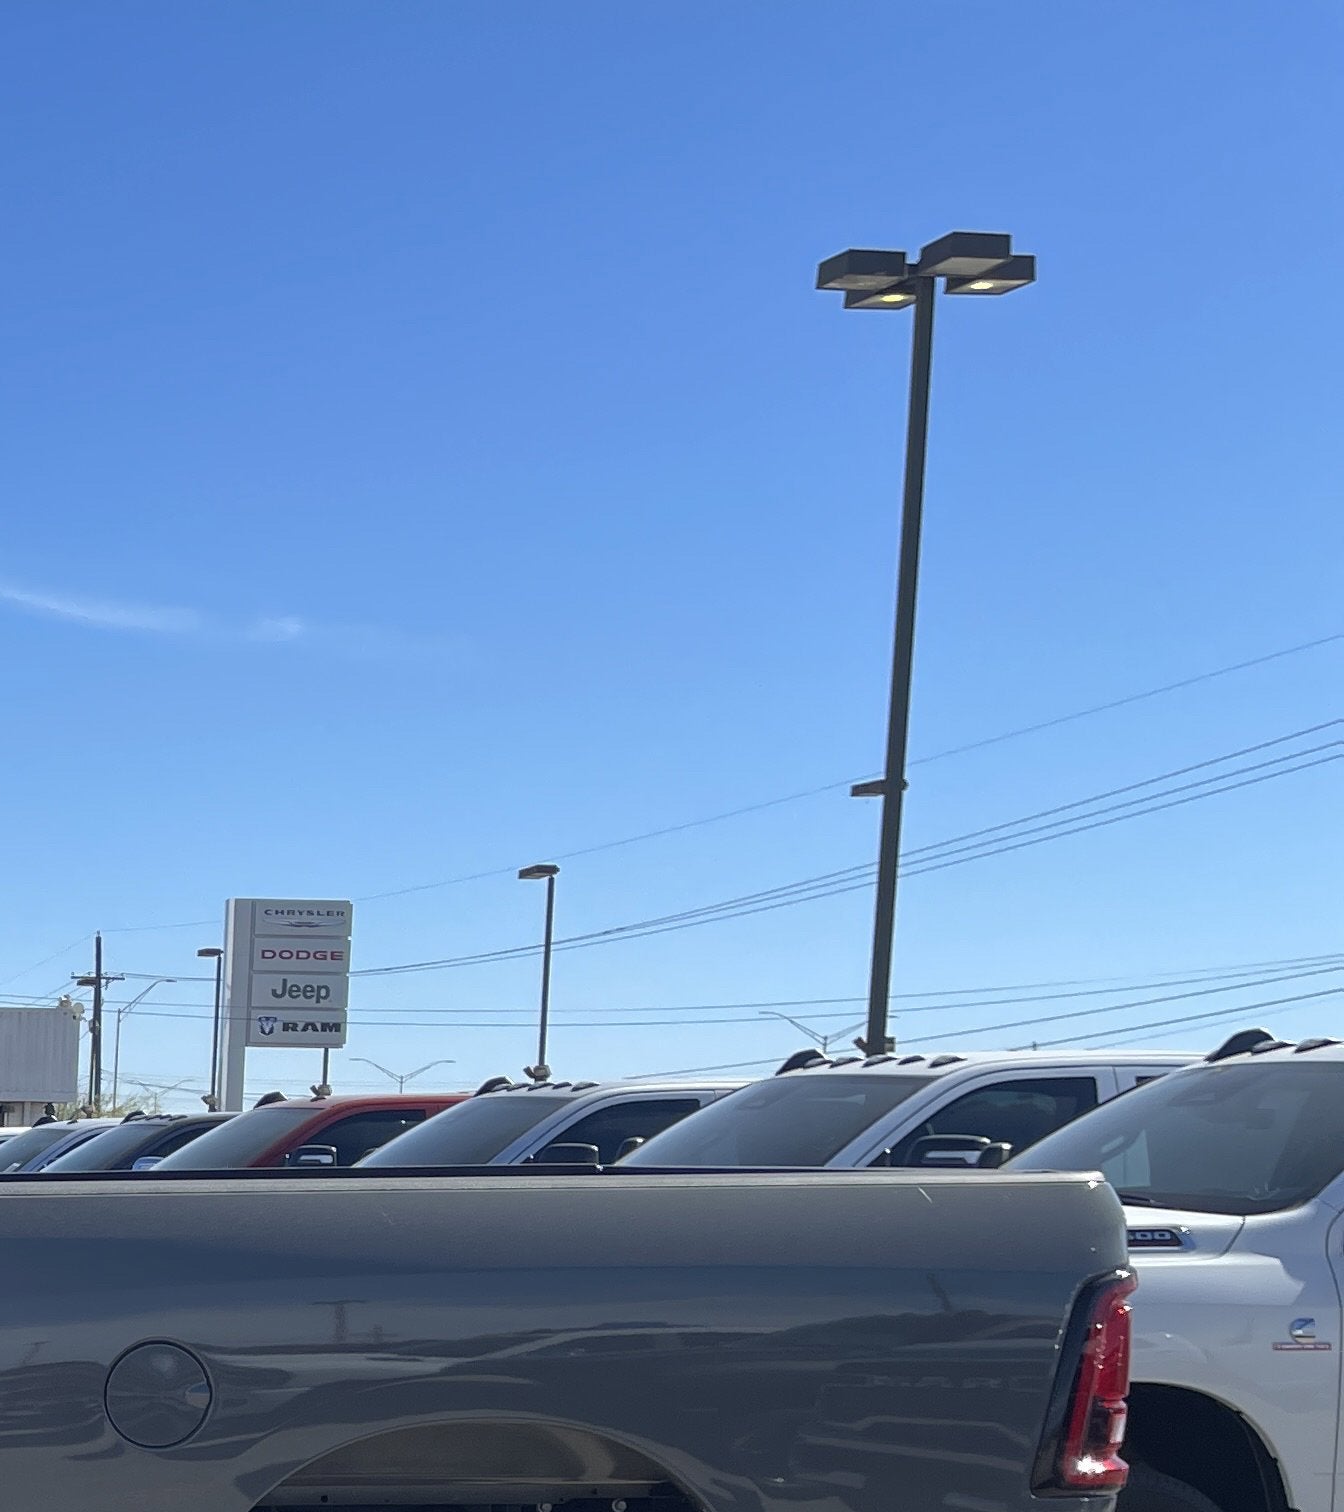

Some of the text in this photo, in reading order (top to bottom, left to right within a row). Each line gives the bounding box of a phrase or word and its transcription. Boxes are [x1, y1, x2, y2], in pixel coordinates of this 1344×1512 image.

[264, 909, 345, 917] CHRYSLER
[261, 950, 345, 961] DODGE
[271, 978, 331, 1004] Jeep
[282, 1022, 342, 1033] RAM
